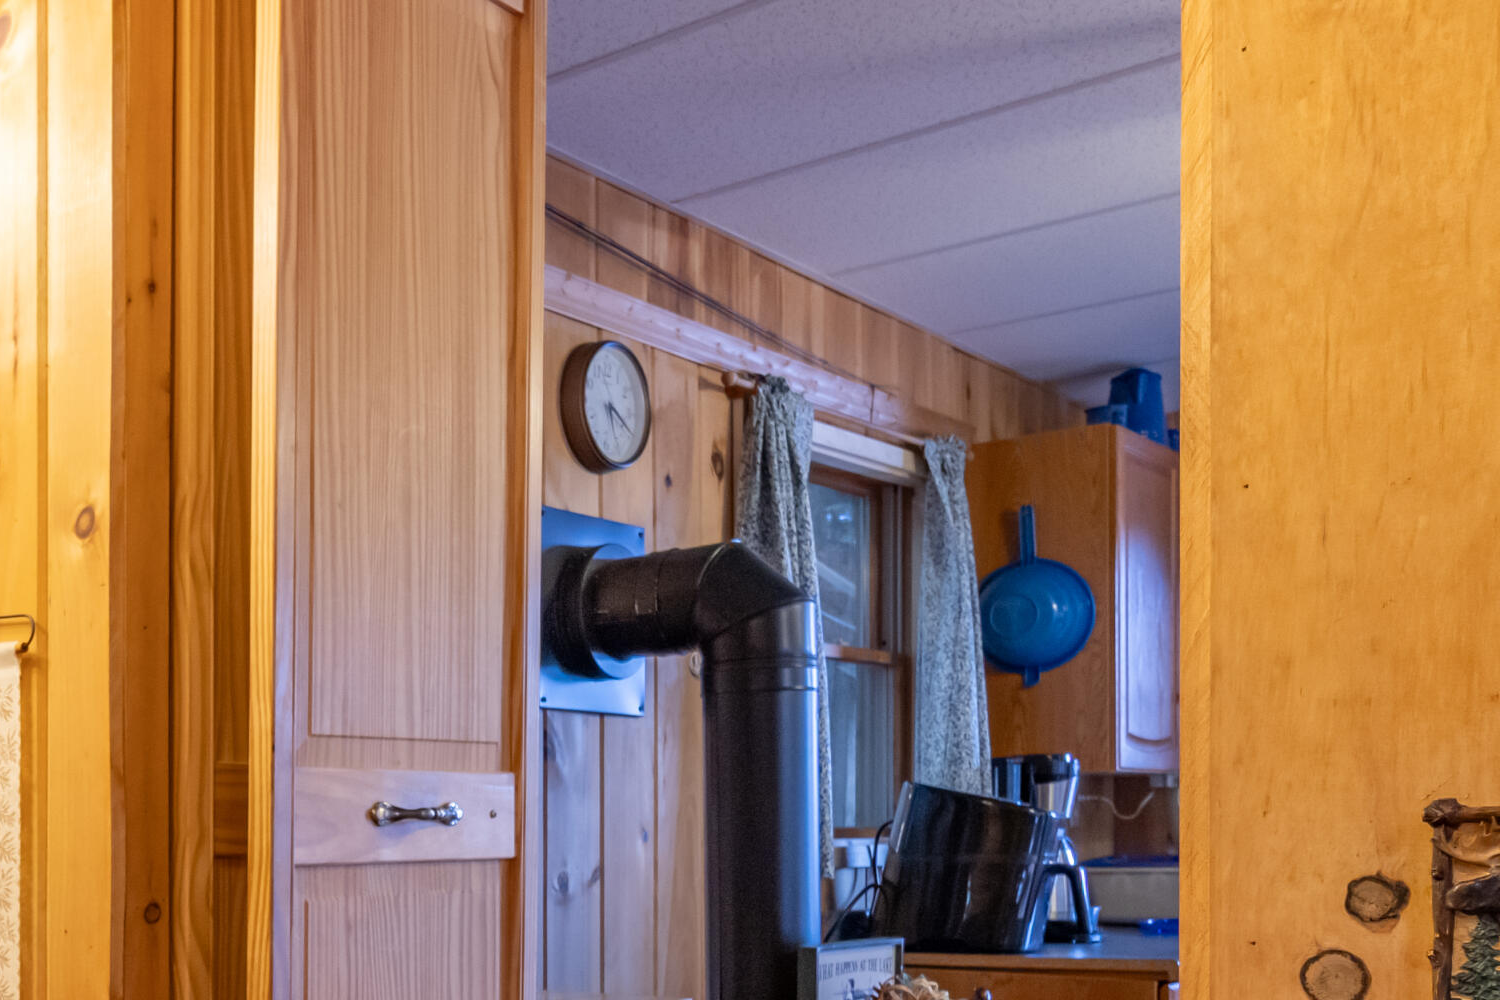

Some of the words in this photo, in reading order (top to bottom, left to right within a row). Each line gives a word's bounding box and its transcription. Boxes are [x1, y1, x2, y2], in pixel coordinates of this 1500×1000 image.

[835, 961, 858, 976] HAPPENS
[860, 960, 867, 972] AT
[867, 958, 878, 972] THE
